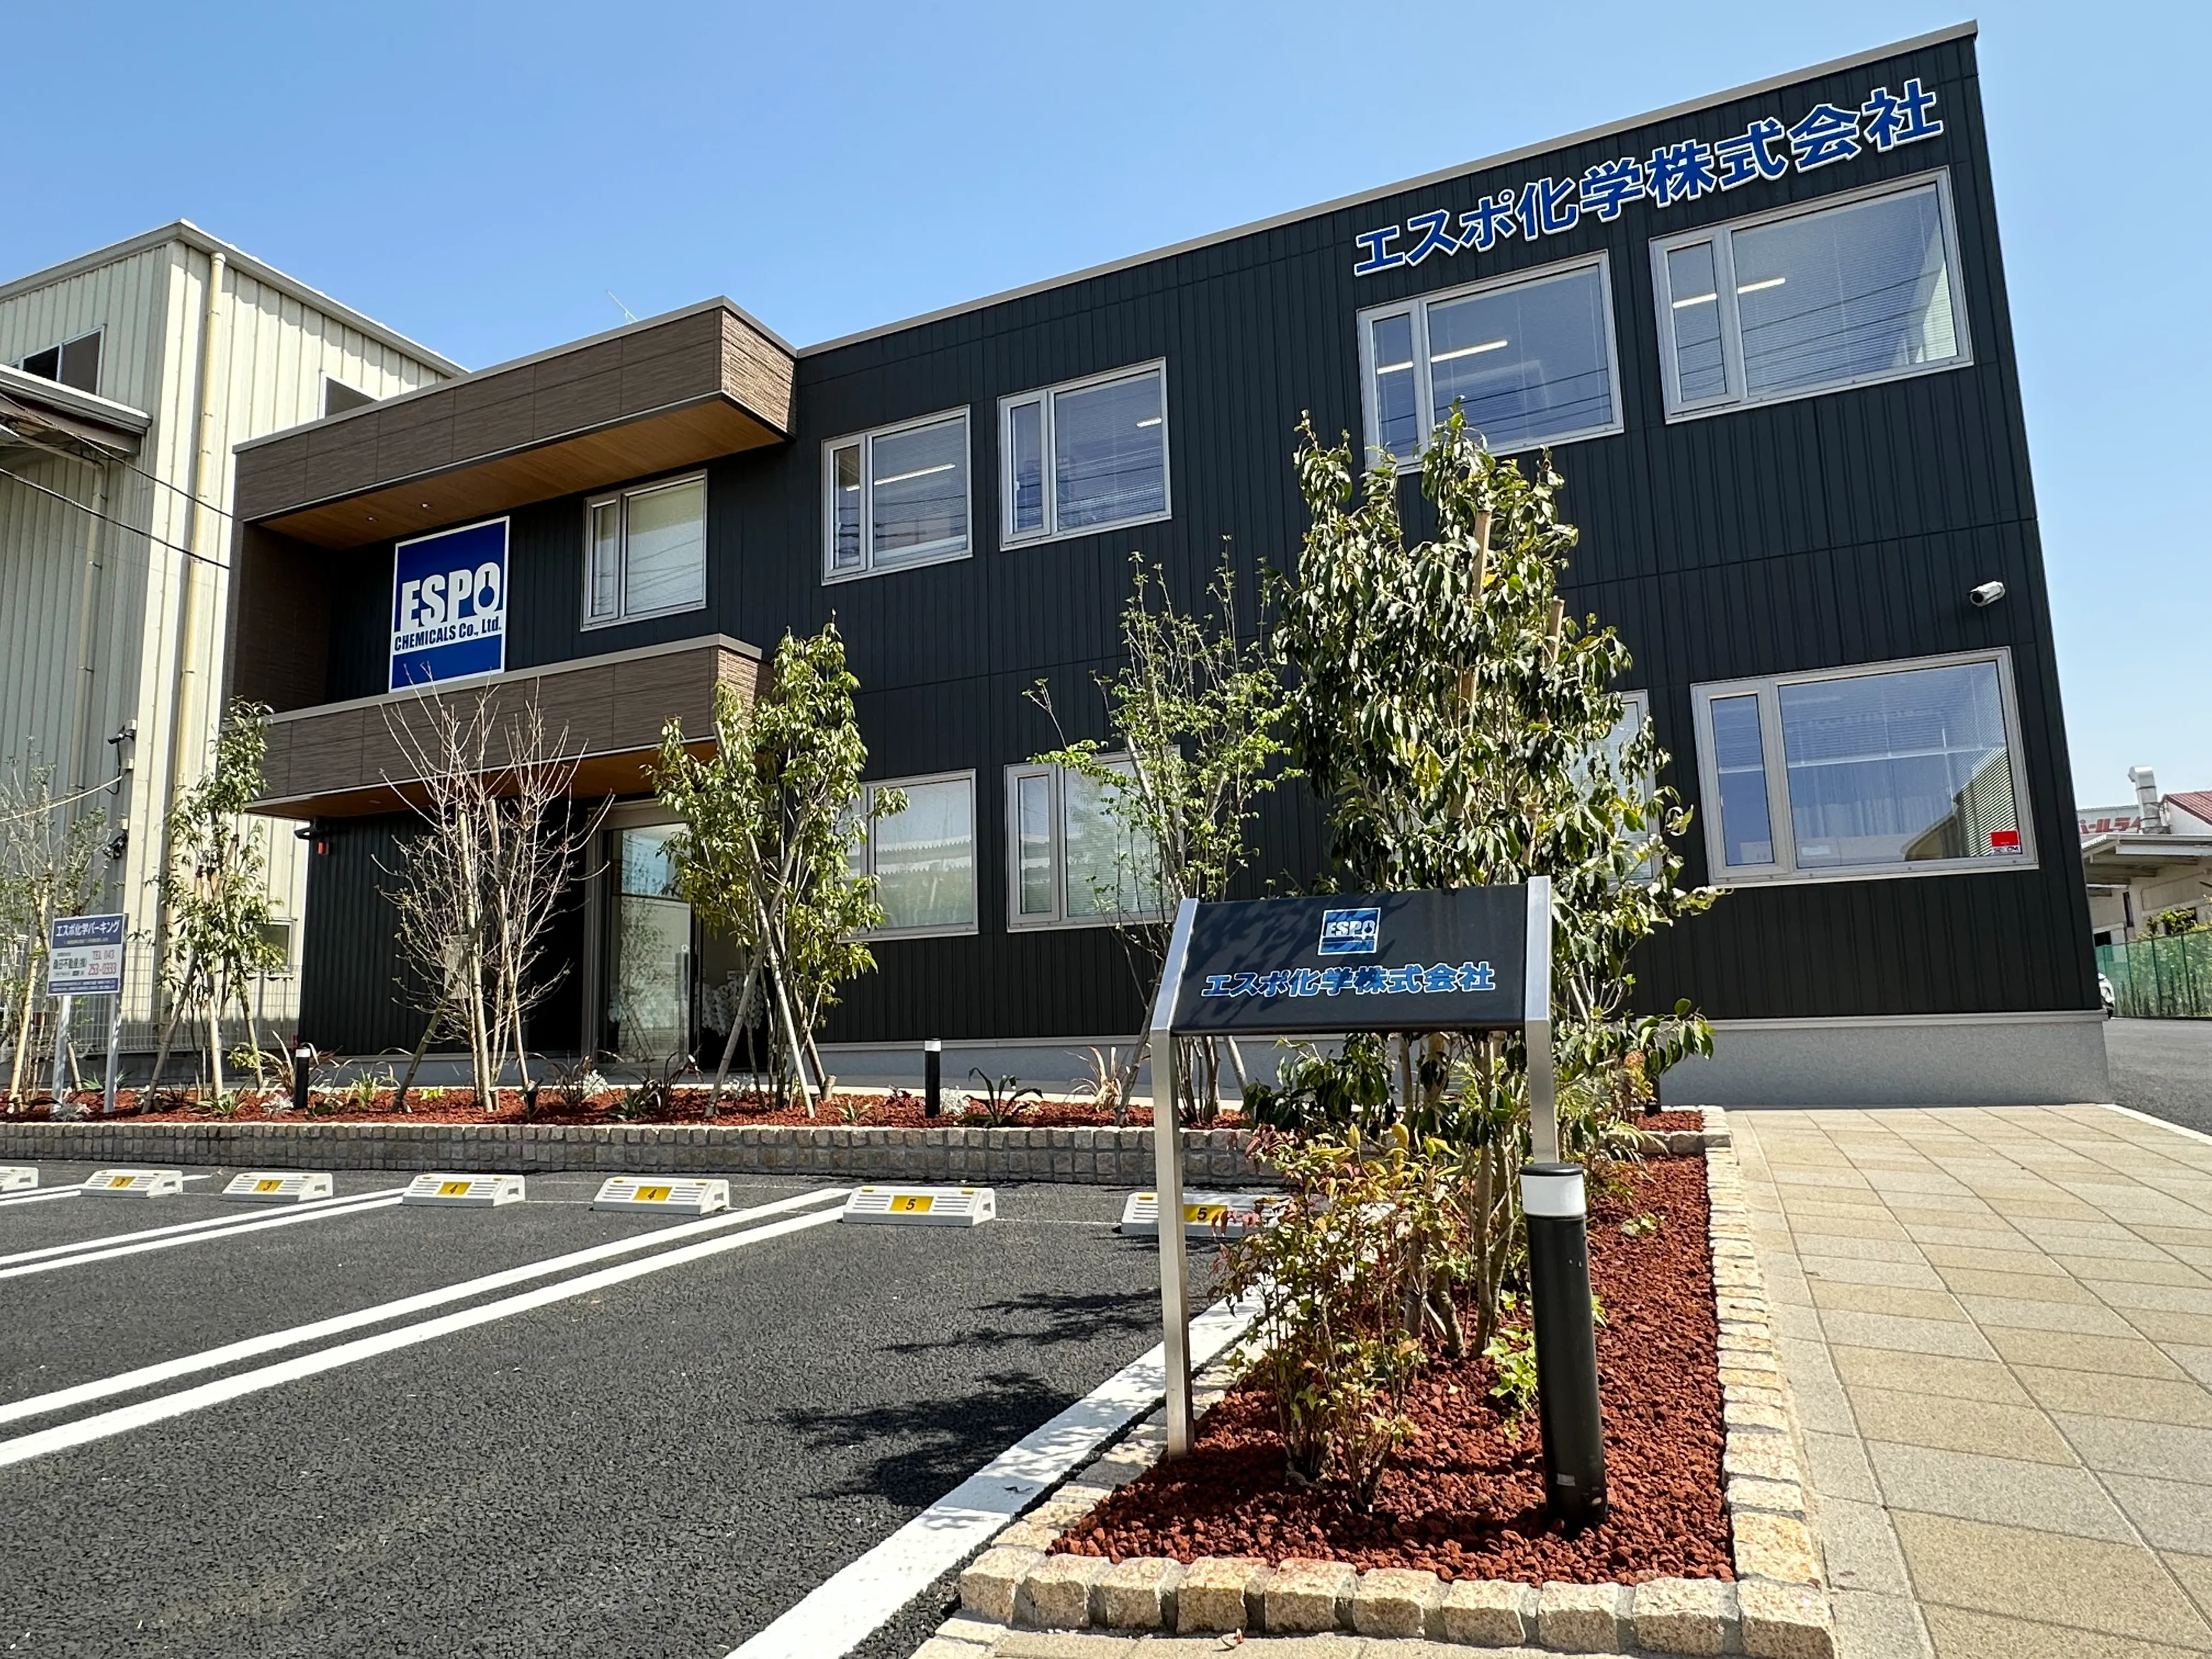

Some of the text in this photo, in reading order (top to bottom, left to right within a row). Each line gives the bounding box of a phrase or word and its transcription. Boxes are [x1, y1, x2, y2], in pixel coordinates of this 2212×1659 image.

[1353, 78, 1944, 277] エスポ化学株式会社
[400, 562, 500, 632] ESPO
[394, 624, 456, 651] CHEMICALS
[482, 616, 502, 634] Ltd.
[1325, 920, 1375, 937] ESPO
[1201, 961, 1496, 997] エスポ化学株式会社
[647, 1188, 657, 1200] 4
[905, 1198, 916, 1210] 5
[1197, 1207, 1207, 1220] 5
